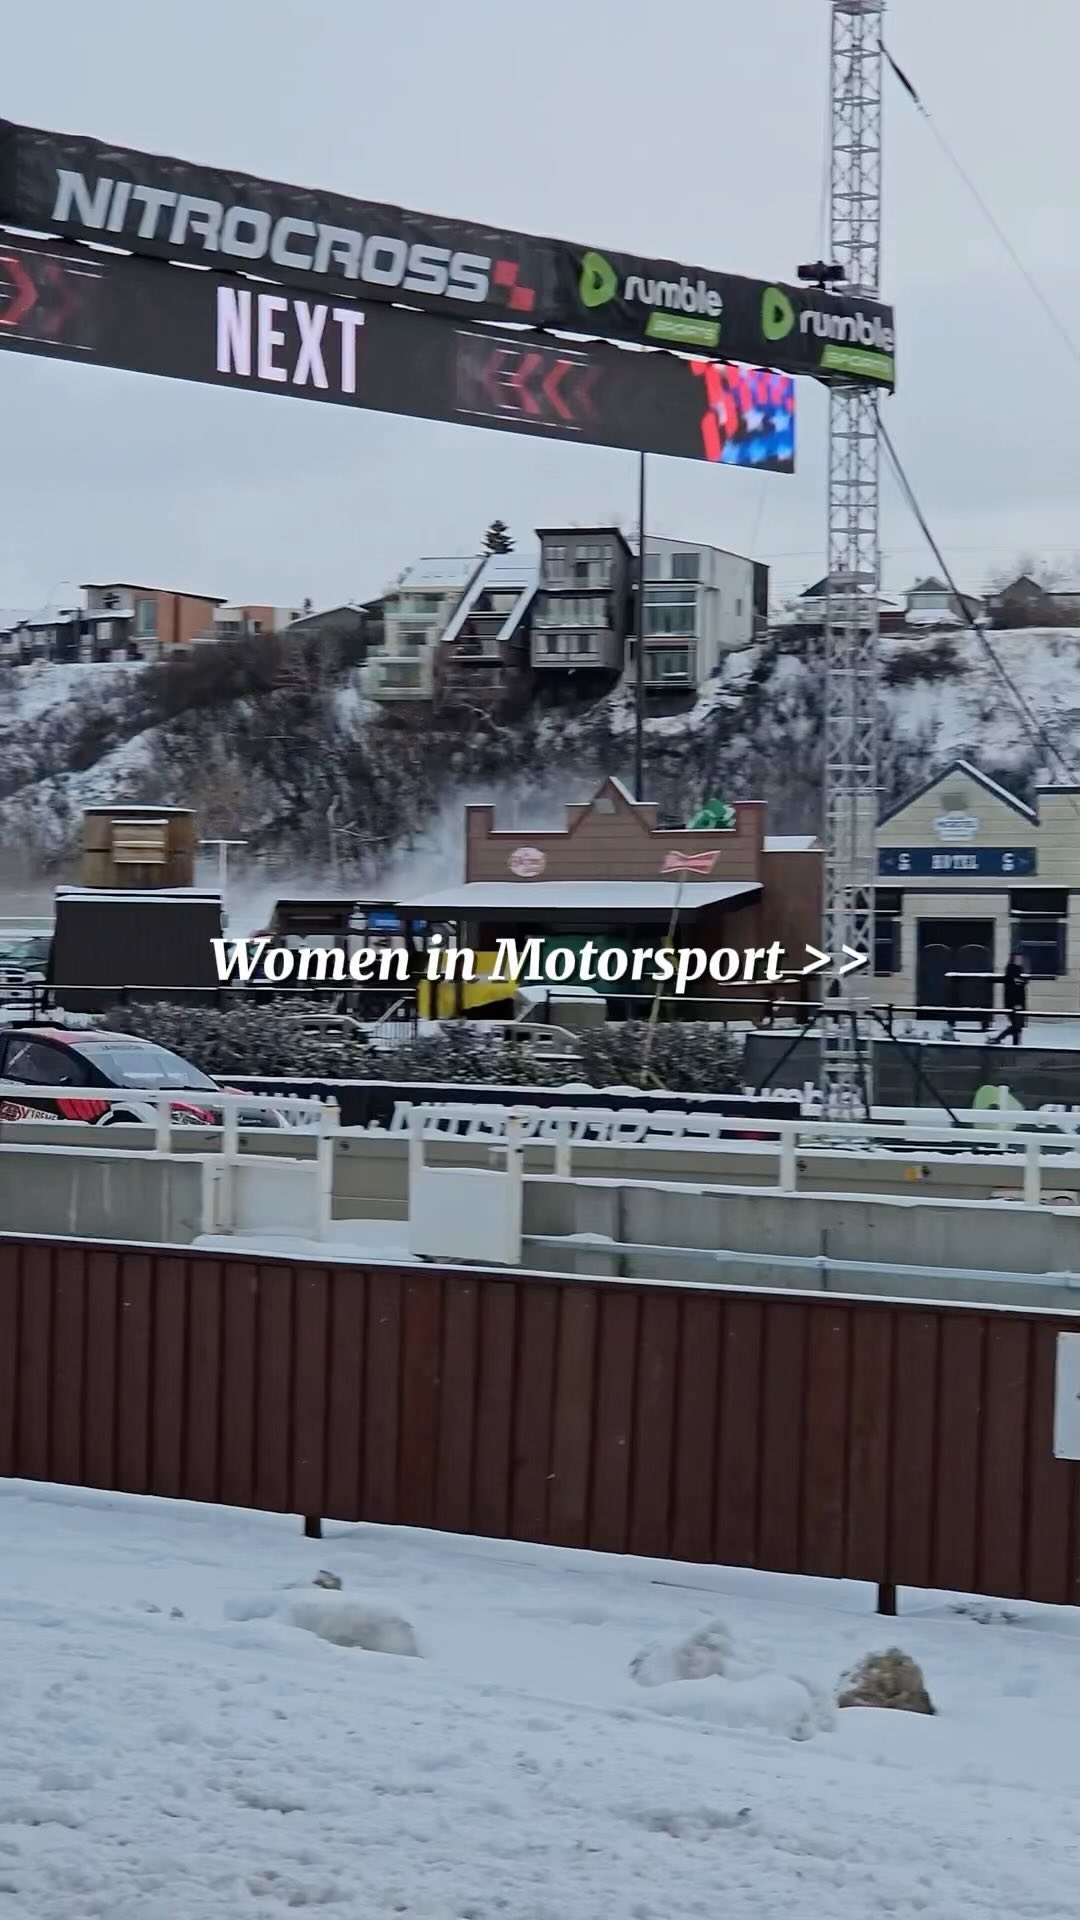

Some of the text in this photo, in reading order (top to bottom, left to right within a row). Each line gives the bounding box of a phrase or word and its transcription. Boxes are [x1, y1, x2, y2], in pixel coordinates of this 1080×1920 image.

[51, 168, 491, 303] NITROCROSS
[624, 275, 723, 317] rumble
[800, 309, 895, 352] rumble
[216, 285, 365, 394] NEXT
